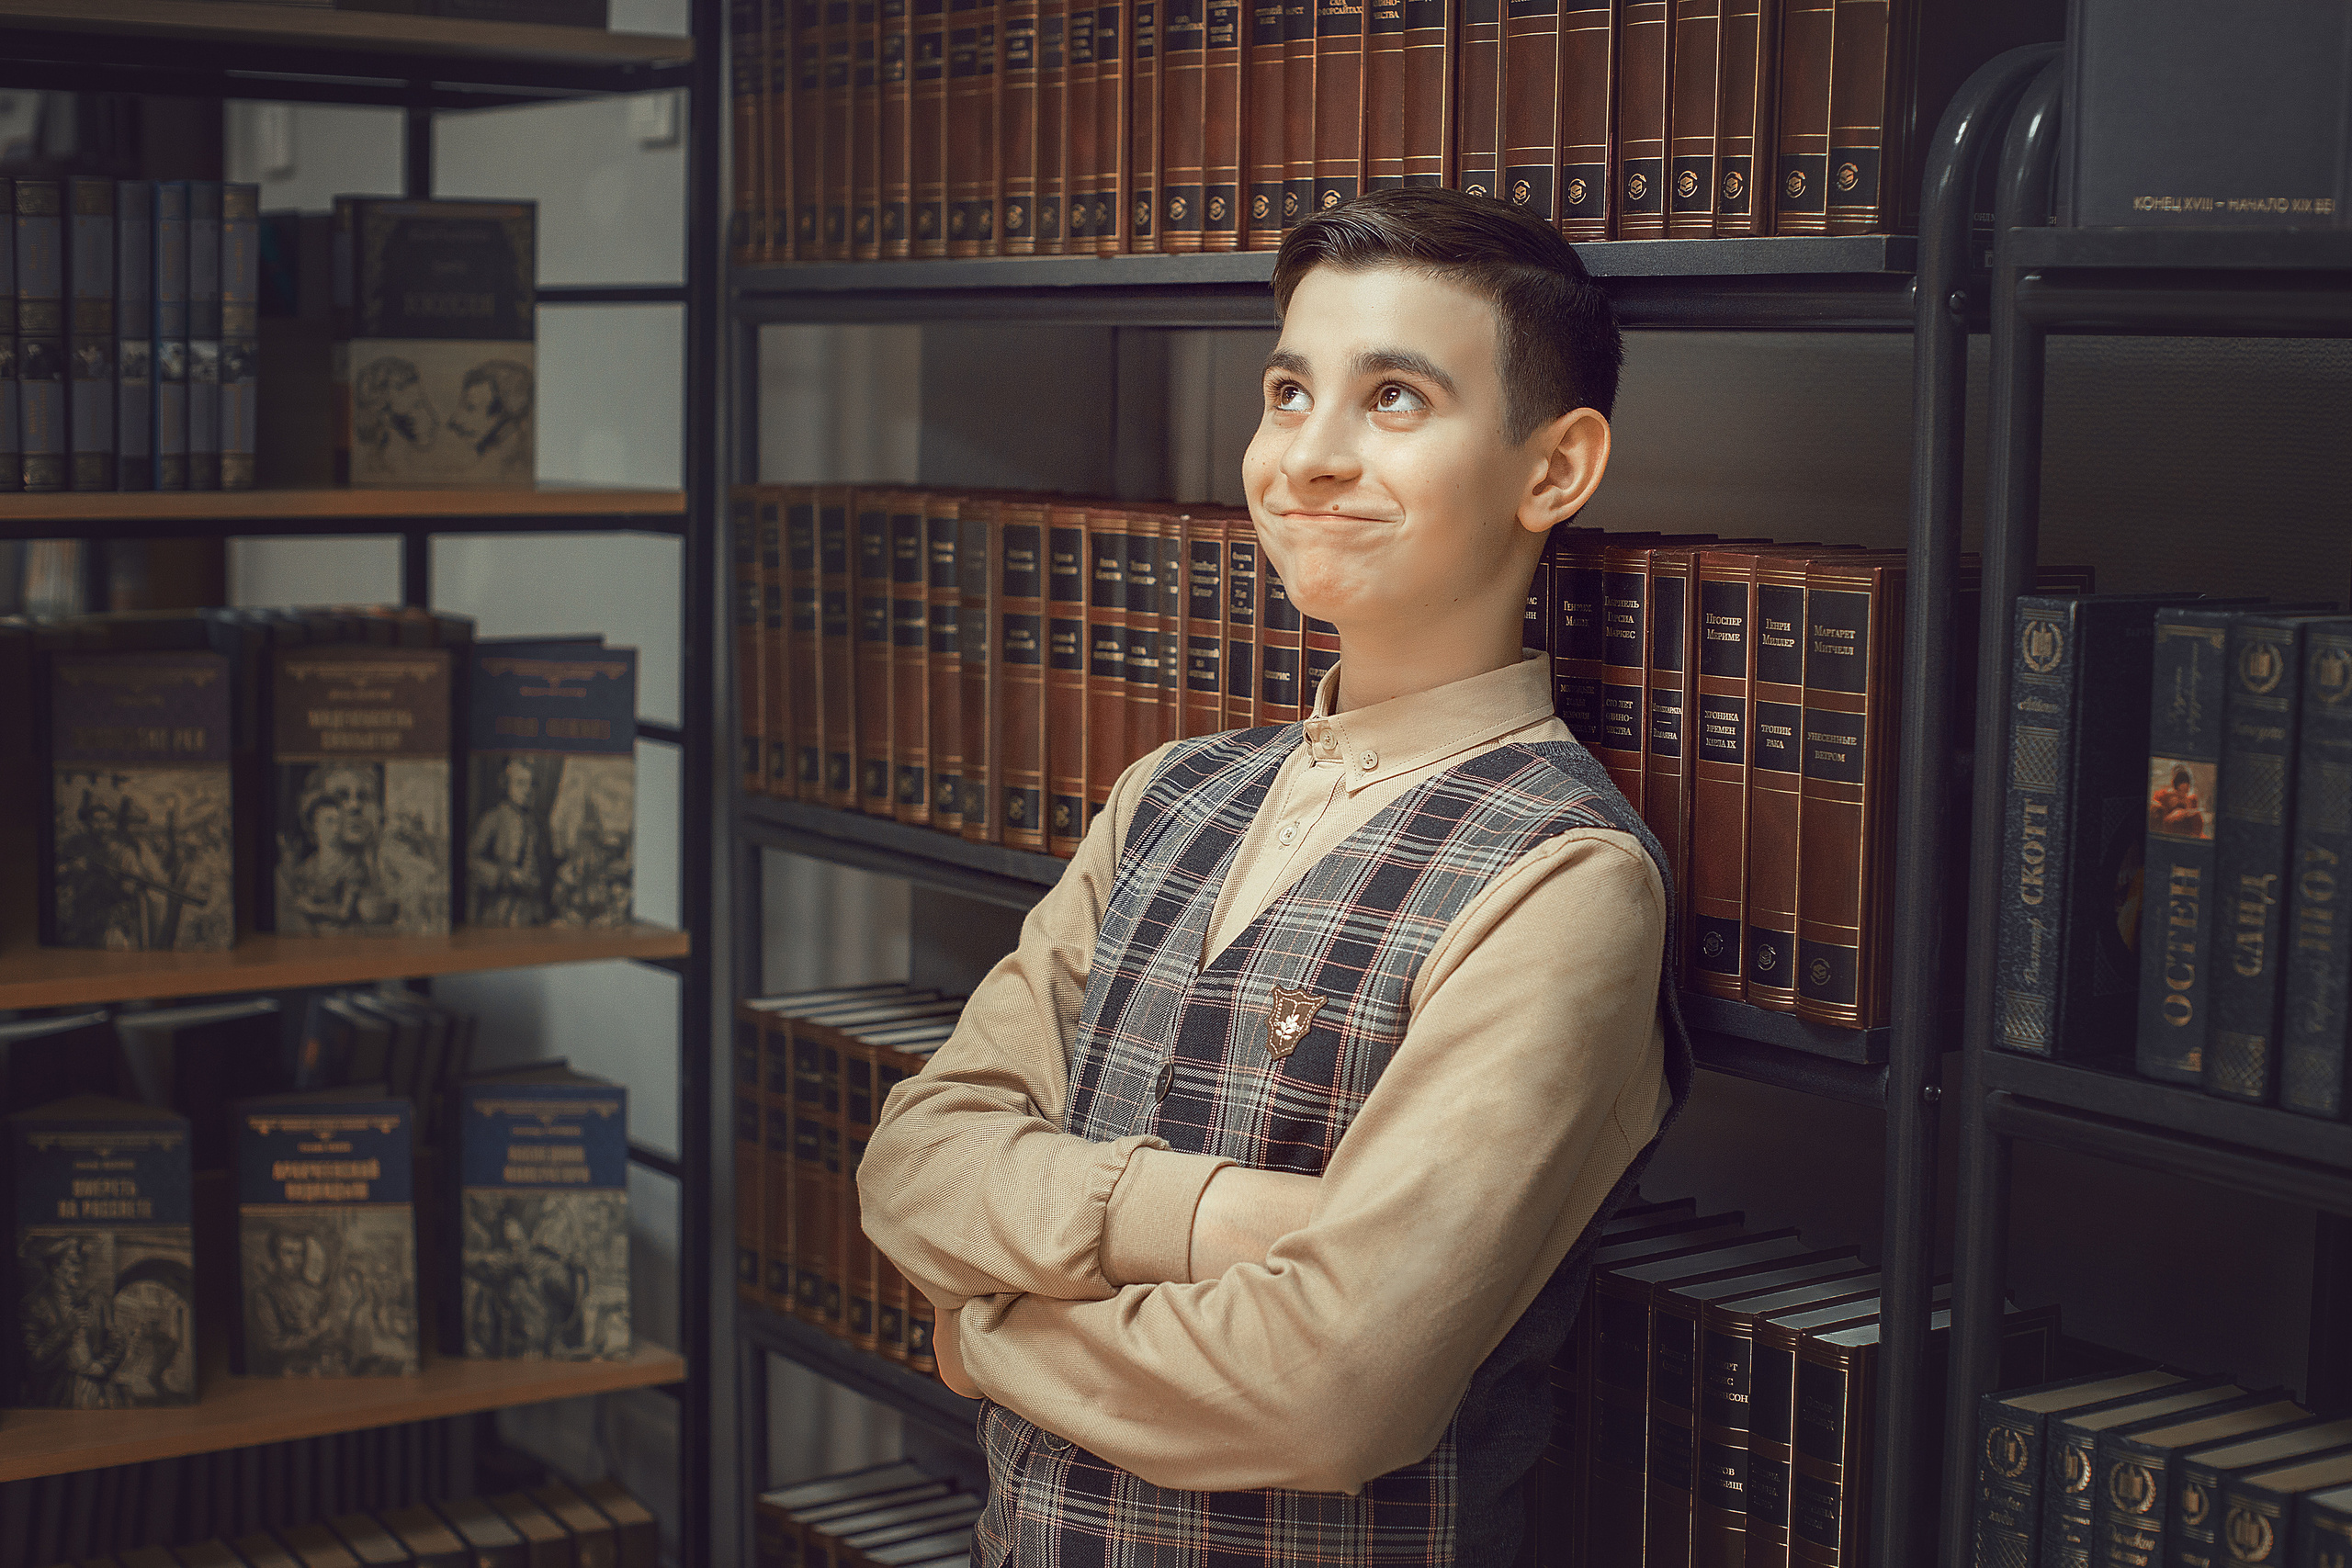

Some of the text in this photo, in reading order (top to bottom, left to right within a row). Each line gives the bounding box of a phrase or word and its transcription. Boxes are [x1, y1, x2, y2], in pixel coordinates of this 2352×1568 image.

[2132, 196, 2181, 213] КОНЕЦ
[2183, 197, 2213, 212] XVIII
[2227, 197, 2290, 213] НАЧАЛО
[2291, 198, 2312, 212] XIX
[1706, 613, 1742, 626] ПРОСПЕР
[1765, 618, 1791, 632] ГЕНРИ
[1606, 626, 1636, 639] МАРКЕС
[1707, 628, 1741, 642] МЕРИМЕ
[1815, 625, 1856, 639] МАРГАРЕТ
[1762, 633, 1795, 648] МИЛЛЕР
[1815, 641, 1854, 656] МИТЧЕЛЛ
[1619, 700, 1634, 709] ЛЕТ
[1704, 710, 1739, 722] ХРОНИКА
[1606, 726, 1632, 736] ЧЕСТВА
[1706, 724, 1736, 736] ВРЕМЕН
[1760, 724, 1792, 736] ТРОПИК
[1766, 739, 1784, 750] РАКА
[1807, 732, 1857, 746] УНЕСЕННЫЕ
[1815, 750, 1846, 762] ВЕТРОМ
[2020, 797, 2048, 906] СКОТТ
[2298, 842, 2338, 953] ШОУ
[2232, 874, 2277, 977] САНД
[2163, 863, 2201, 1028] ОСТЕН
